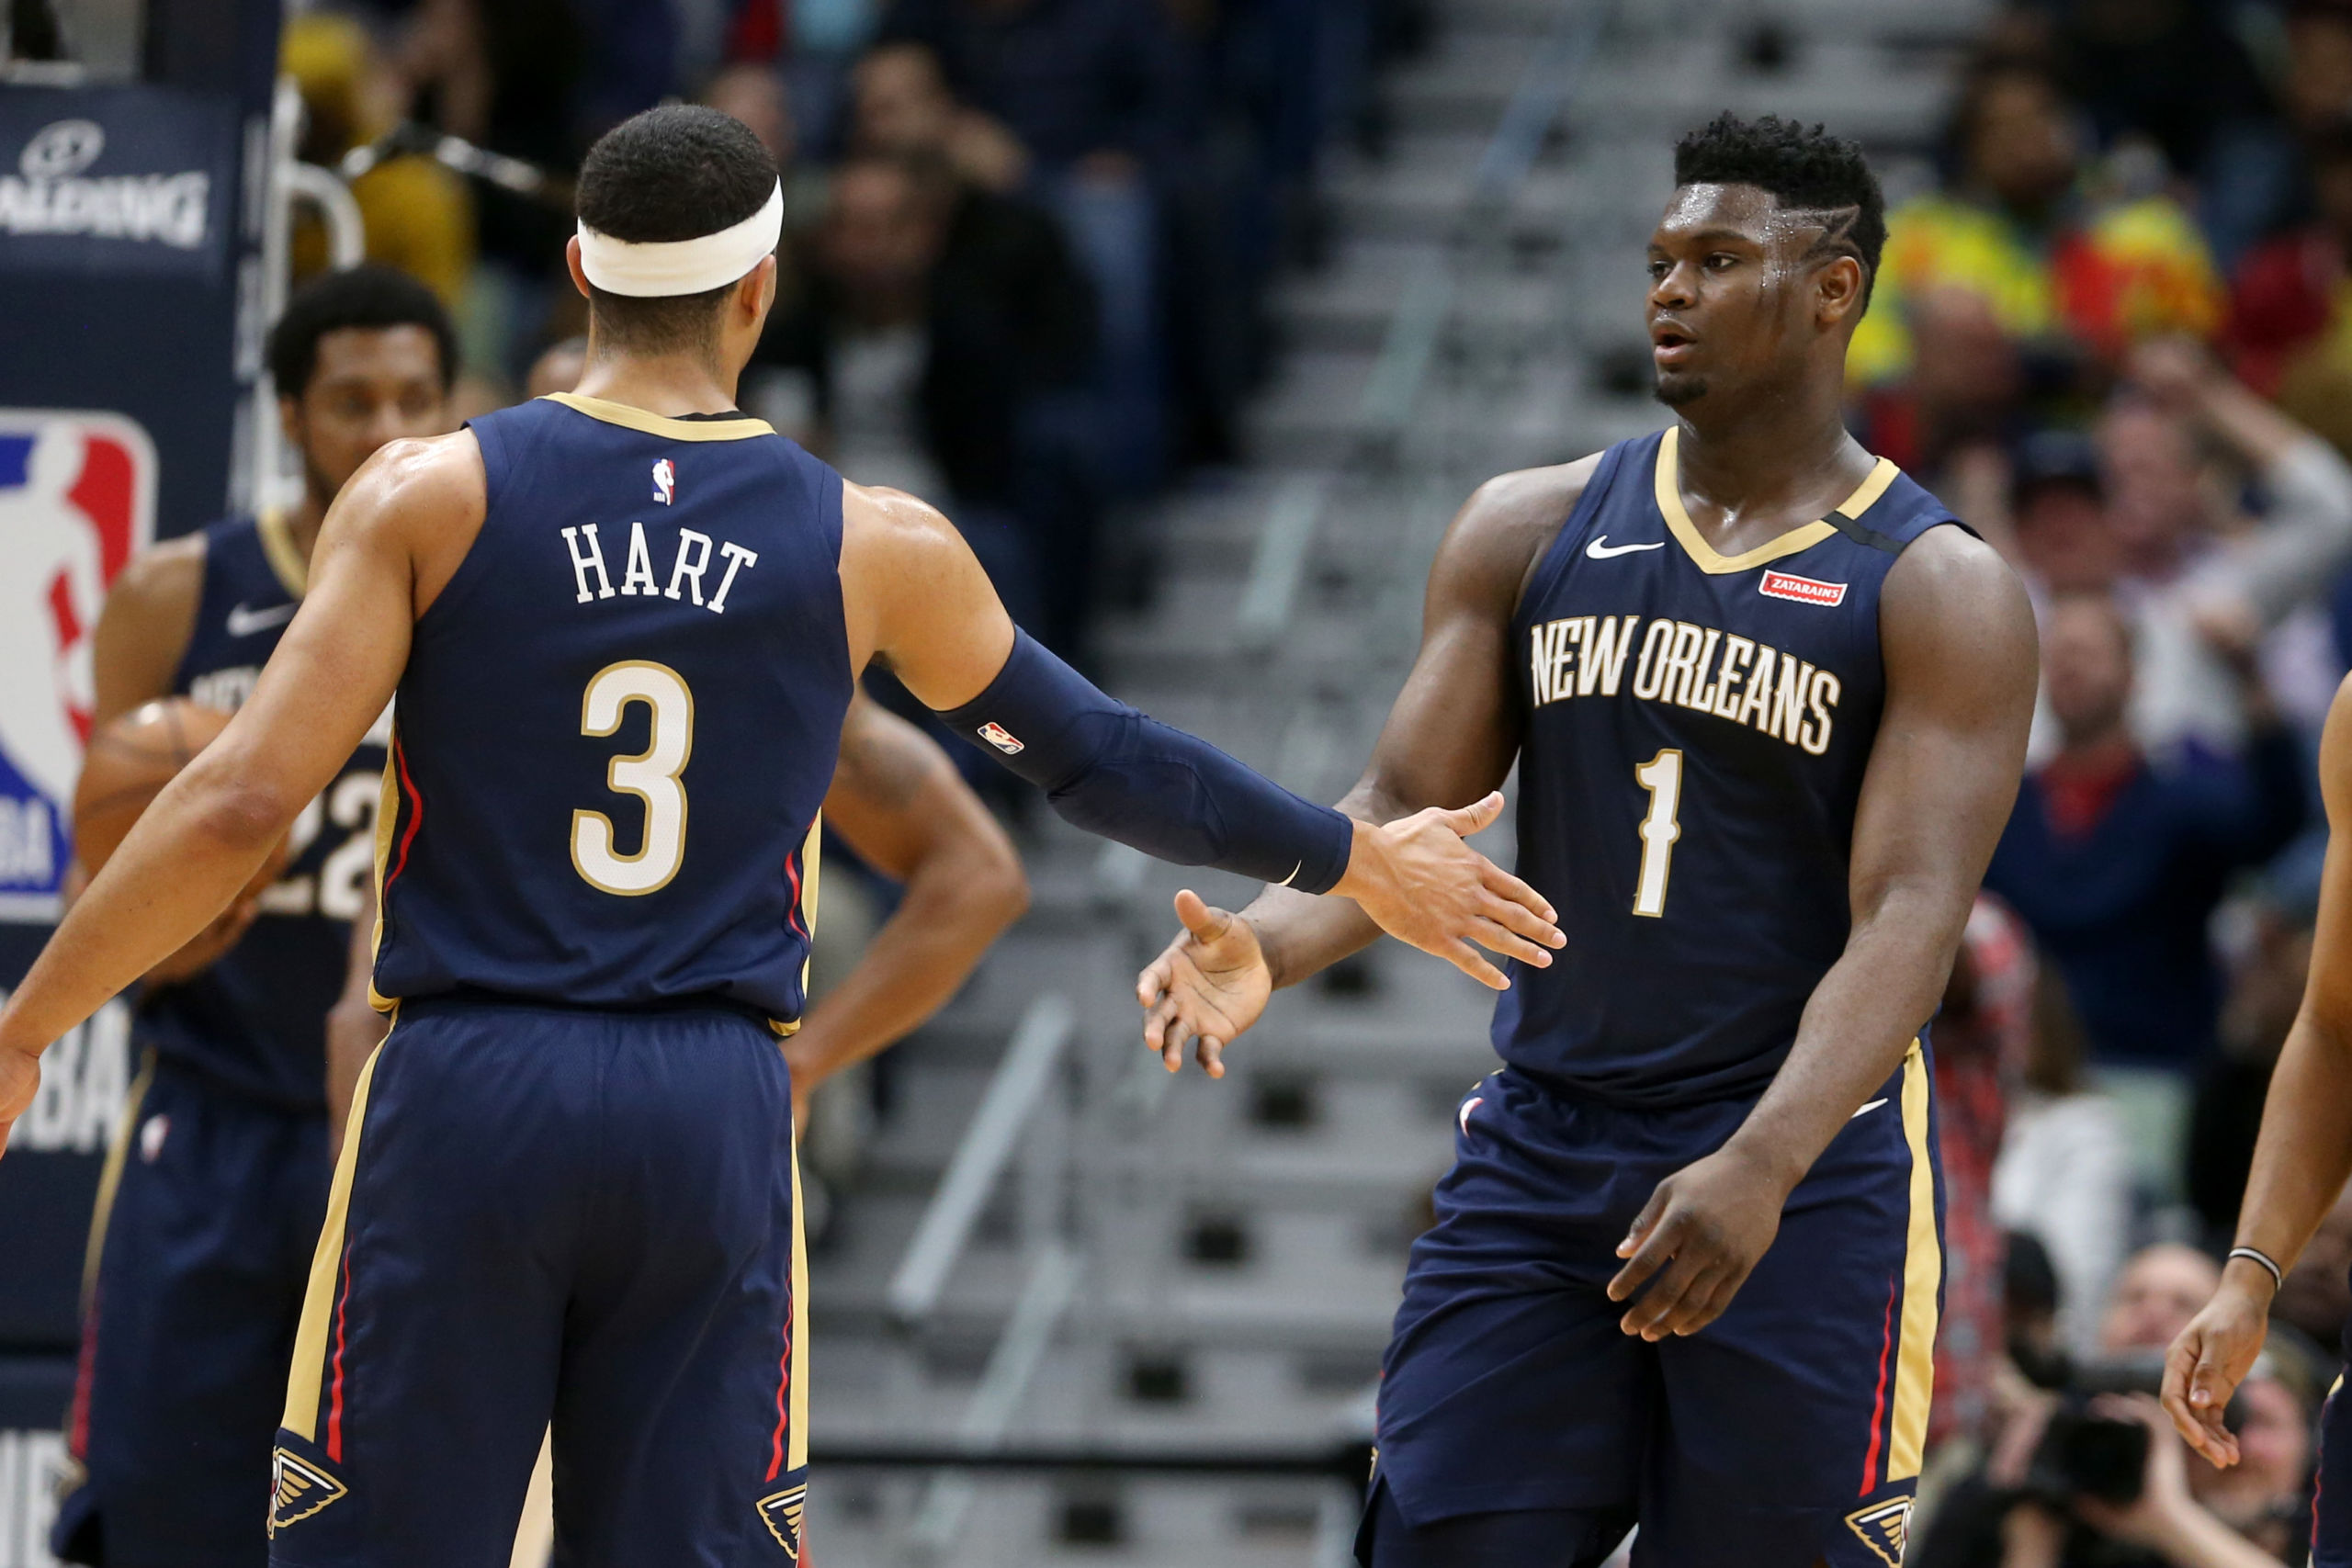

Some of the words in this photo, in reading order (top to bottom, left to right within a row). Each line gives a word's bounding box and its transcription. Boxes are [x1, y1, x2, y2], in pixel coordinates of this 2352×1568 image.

[0, 172, 209, 247] ALDING
[560, 522, 759, 615] HART
[1530, 615, 1641, 707] NEW
[1633, 618, 1840, 755] ORLEANS
[570, 659, 695, 897] 3
[1632, 748, 1683, 919] 1
[9, 995, 130, 1153] BA
